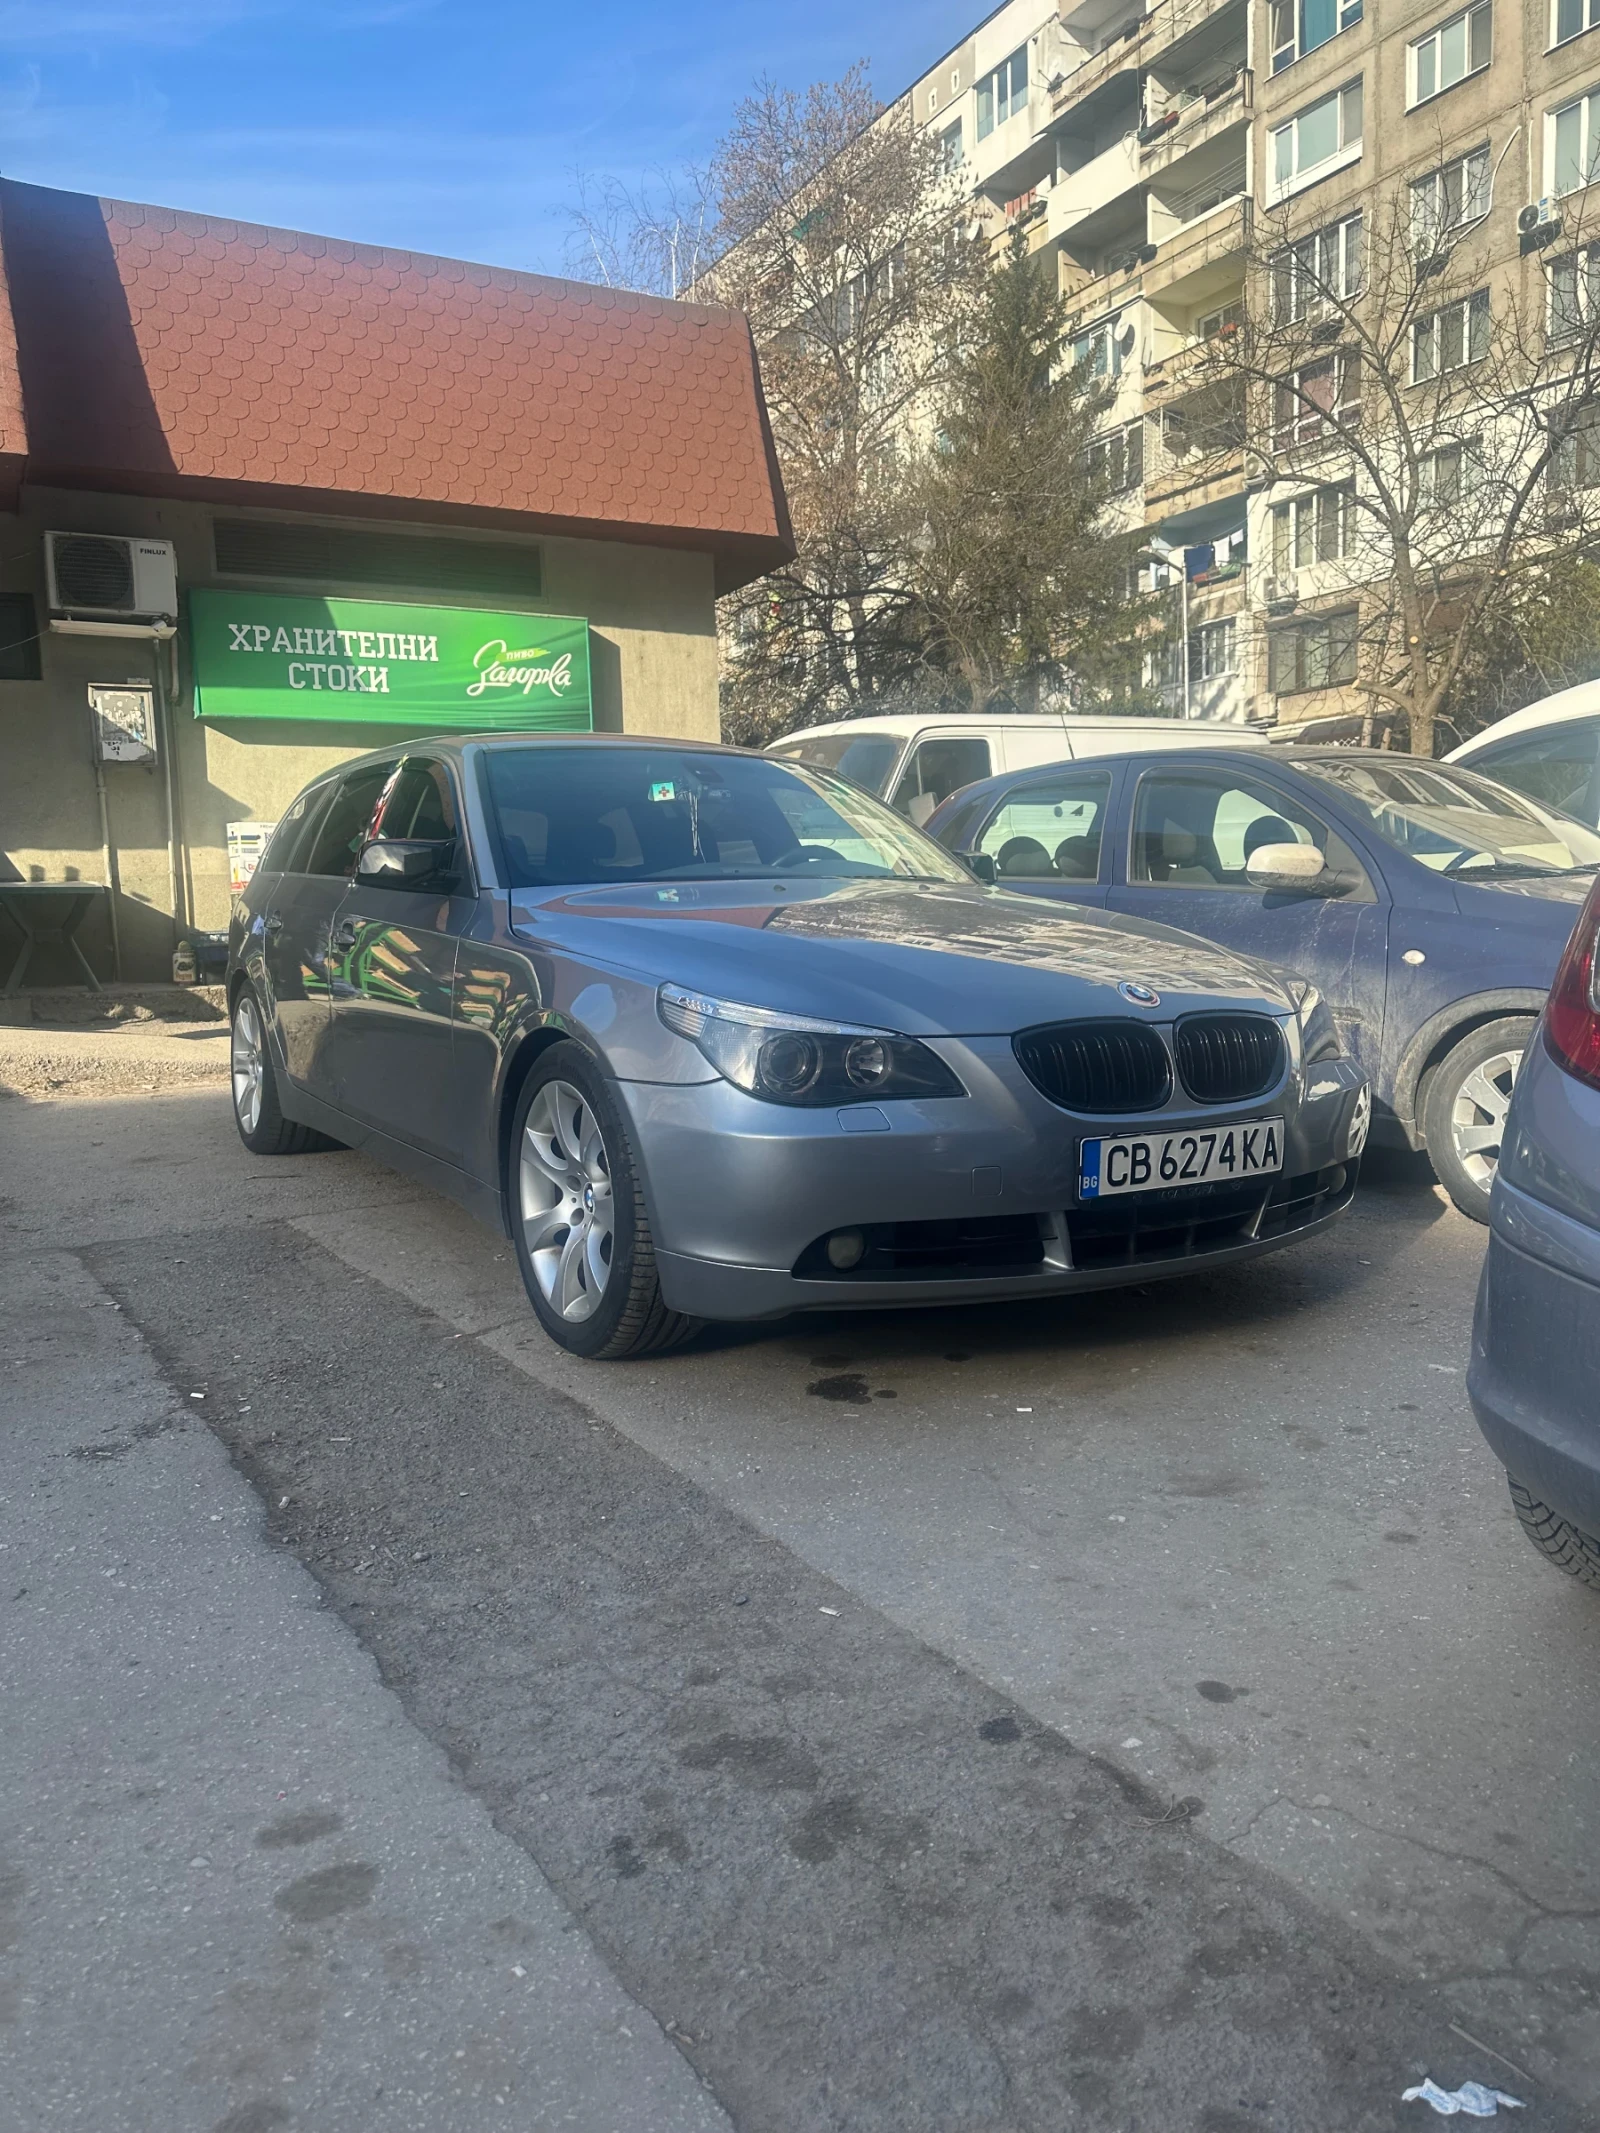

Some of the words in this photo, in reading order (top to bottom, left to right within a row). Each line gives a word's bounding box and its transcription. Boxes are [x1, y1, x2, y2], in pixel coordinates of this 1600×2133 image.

[140, 548, 167, 556] FINLUX
[228, 623, 439, 662] ХРАНИТЕЛНИ
[506, 649, 535, 660] ПИВО
[288, 662, 390, 693] СТОКИ
[466, 639, 572, 697] Загорка
[1083, 1175, 1098, 1189] BG
